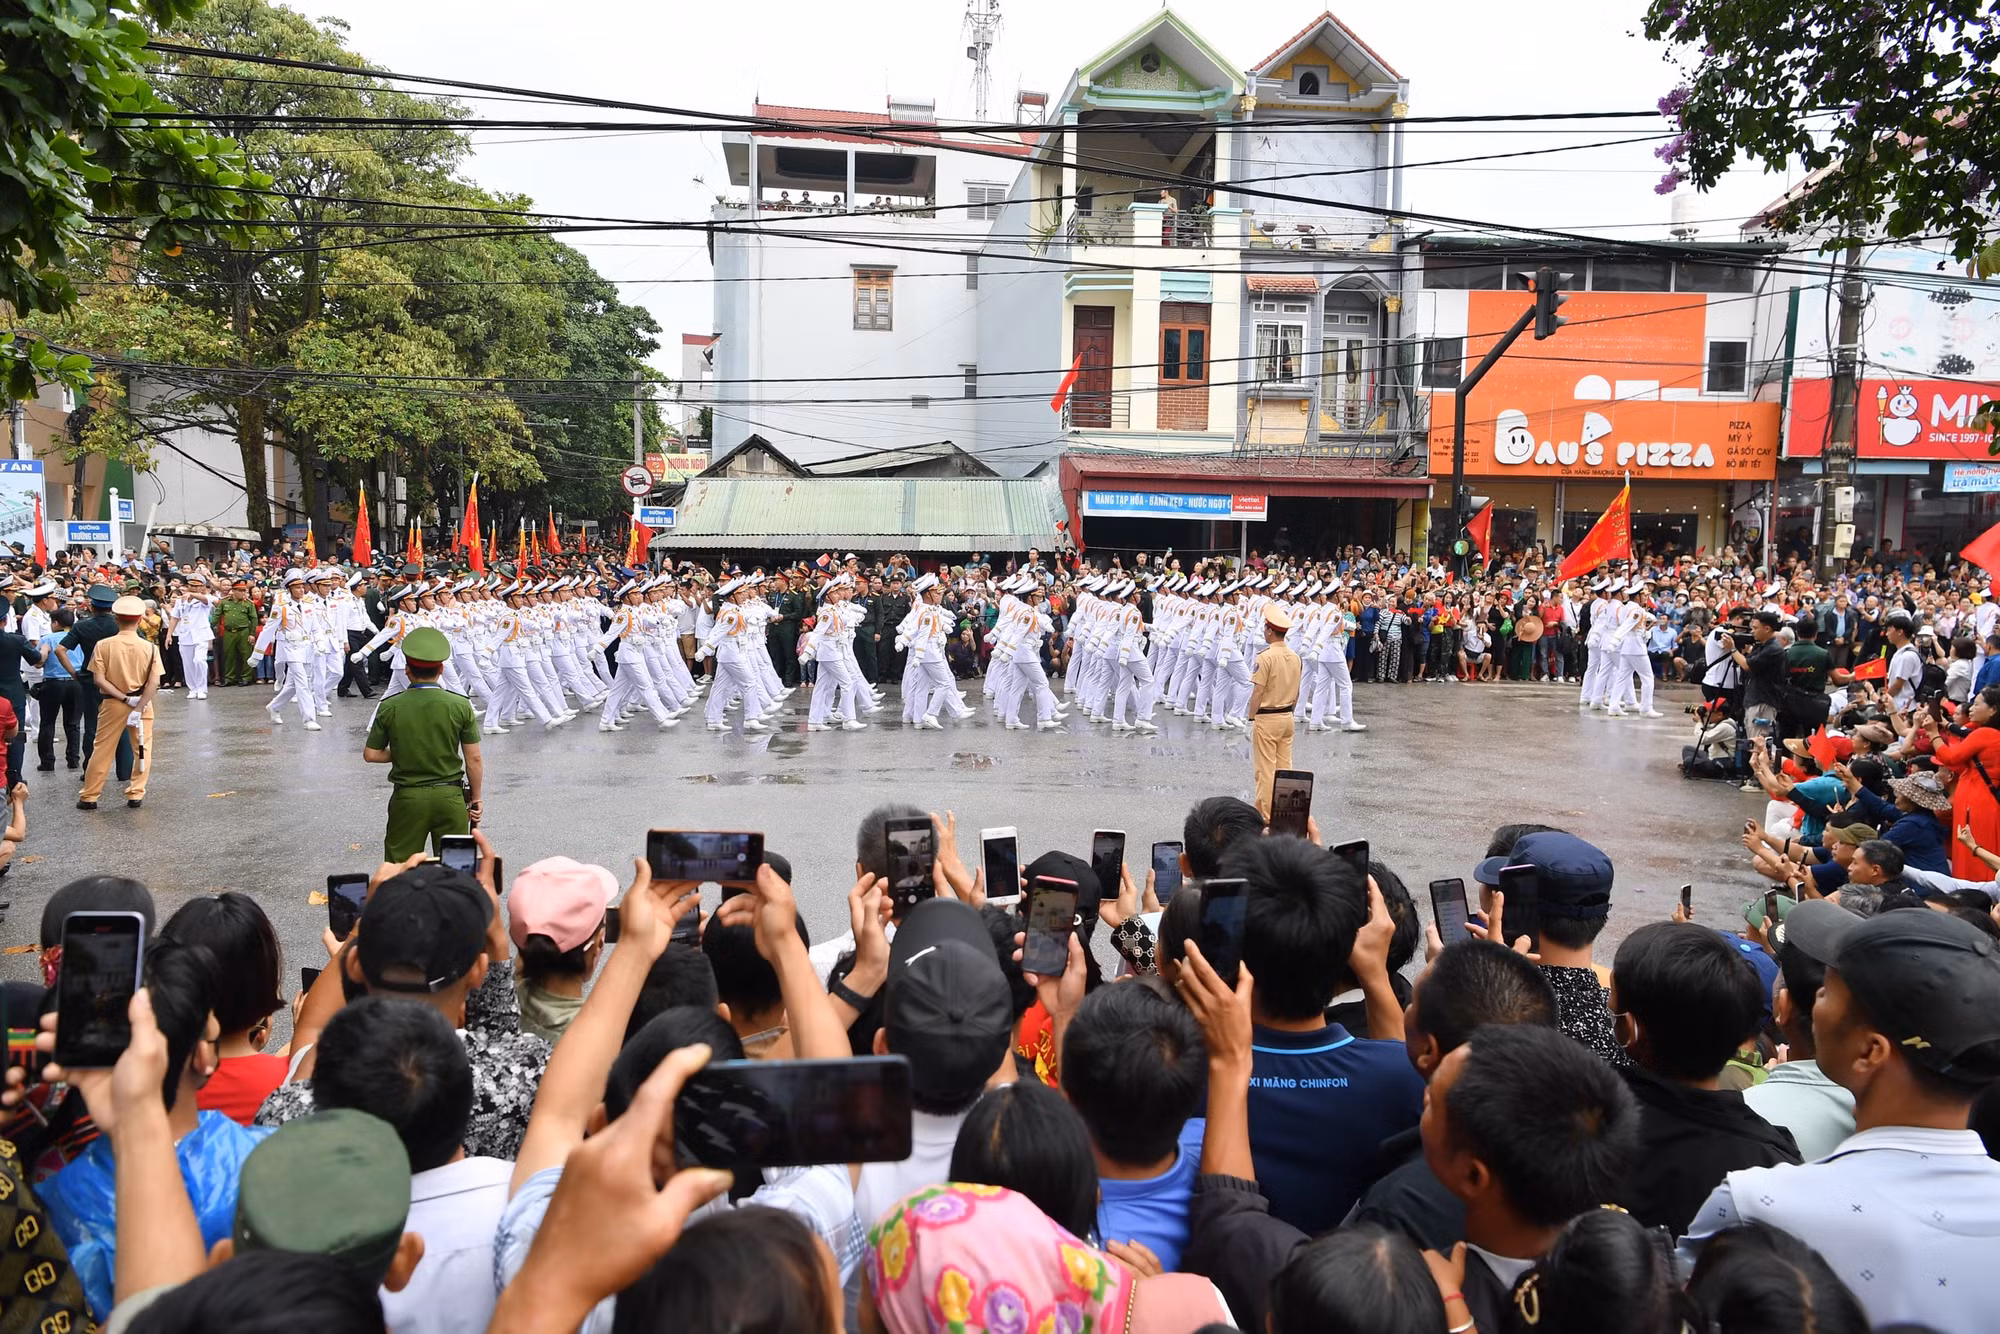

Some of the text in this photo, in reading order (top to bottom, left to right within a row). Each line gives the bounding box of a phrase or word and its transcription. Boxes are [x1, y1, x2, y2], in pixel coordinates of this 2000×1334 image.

[1729, 421, 1751, 430] PIZZA
[1929, 433, 1958, 443] SINCE
[1960, 434, 1979, 443] 1997
[1617, 442, 1715, 468] PIZZA
[1756, 447, 1772, 455] CAY
[11, 462, 33, 471] ÁN
[1095, 493, 1114, 505] HÀNG
[1116, 494, 1129, 507] TẠP
[1208, 498, 1226, 511] NGỌT
[1263, 1076, 1297, 1088] MĂNG
[1299, 1078, 1349, 1088] CHINFON
